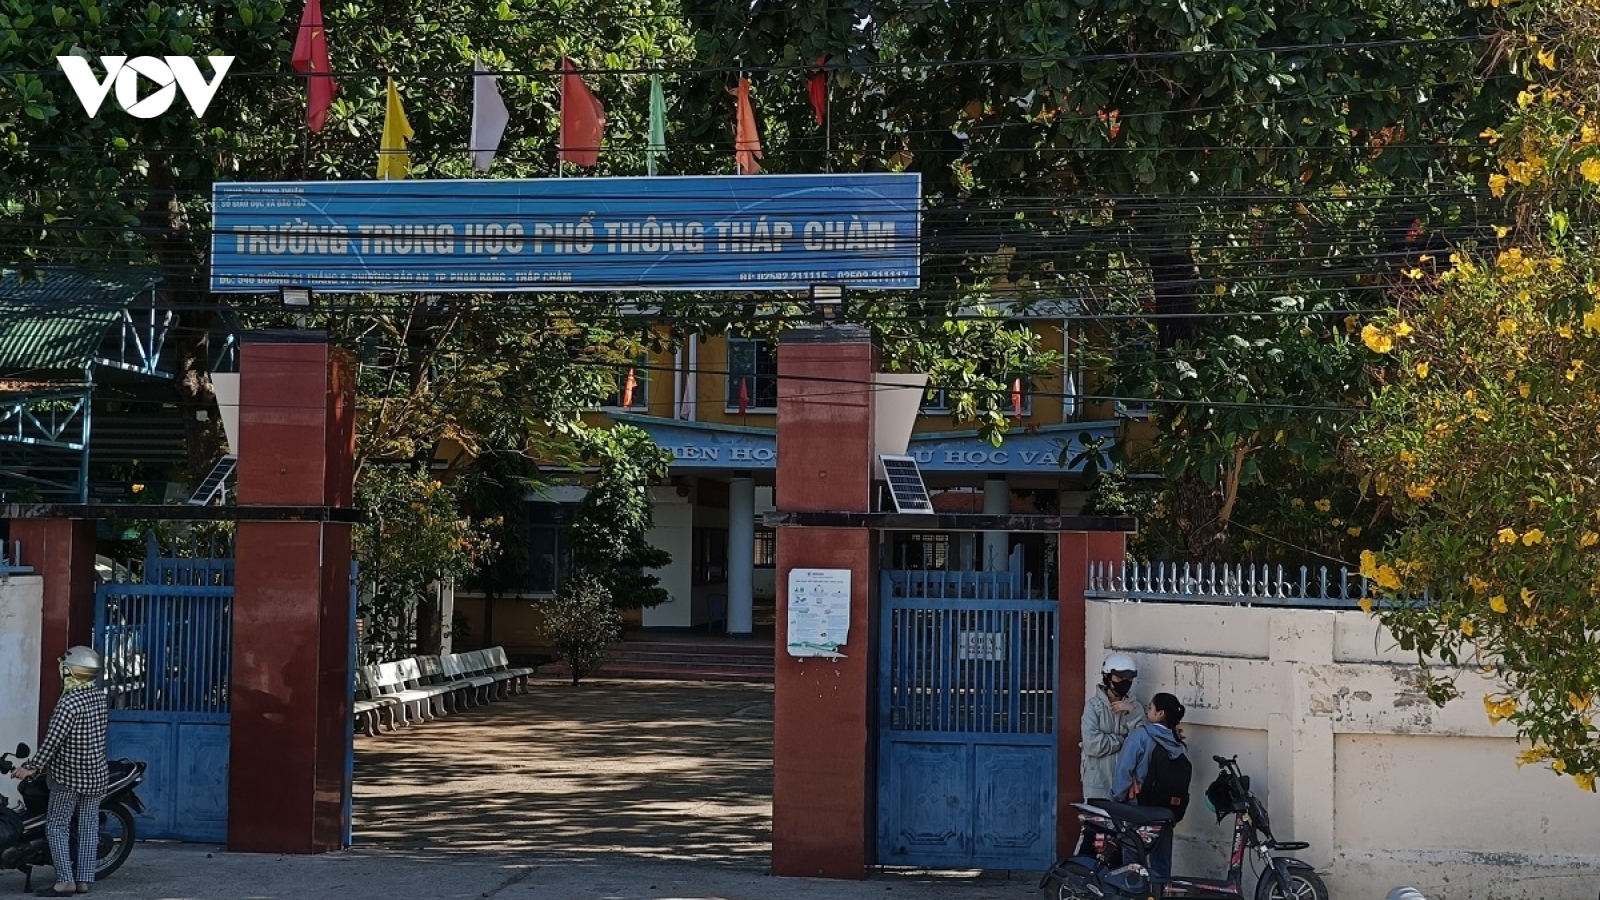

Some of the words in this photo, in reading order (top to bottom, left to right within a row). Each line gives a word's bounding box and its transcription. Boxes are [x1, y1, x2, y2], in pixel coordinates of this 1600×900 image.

[233, 217, 348, 255] TRƯỜNG
[358, 224, 455, 255] TRUNG
[465, 223, 524, 260] HỌC
[534, 210, 597, 254] PHỔ
[604, 215, 704, 254] THÔNG
[714, 214, 793, 253] THÁP
[803, 214, 897, 251] CHÀM
[306, 270, 338, 284] THÁNG
[450, 272, 477, 282] PHAN
[479, 272, 506, 282] RANG
[515, 270, 541, 282] THÁP
[543, 270, 573, 282] CHÀM
[729, 447, 777, 465] HỌ
[943, 449, 1009, 468] HỌC
